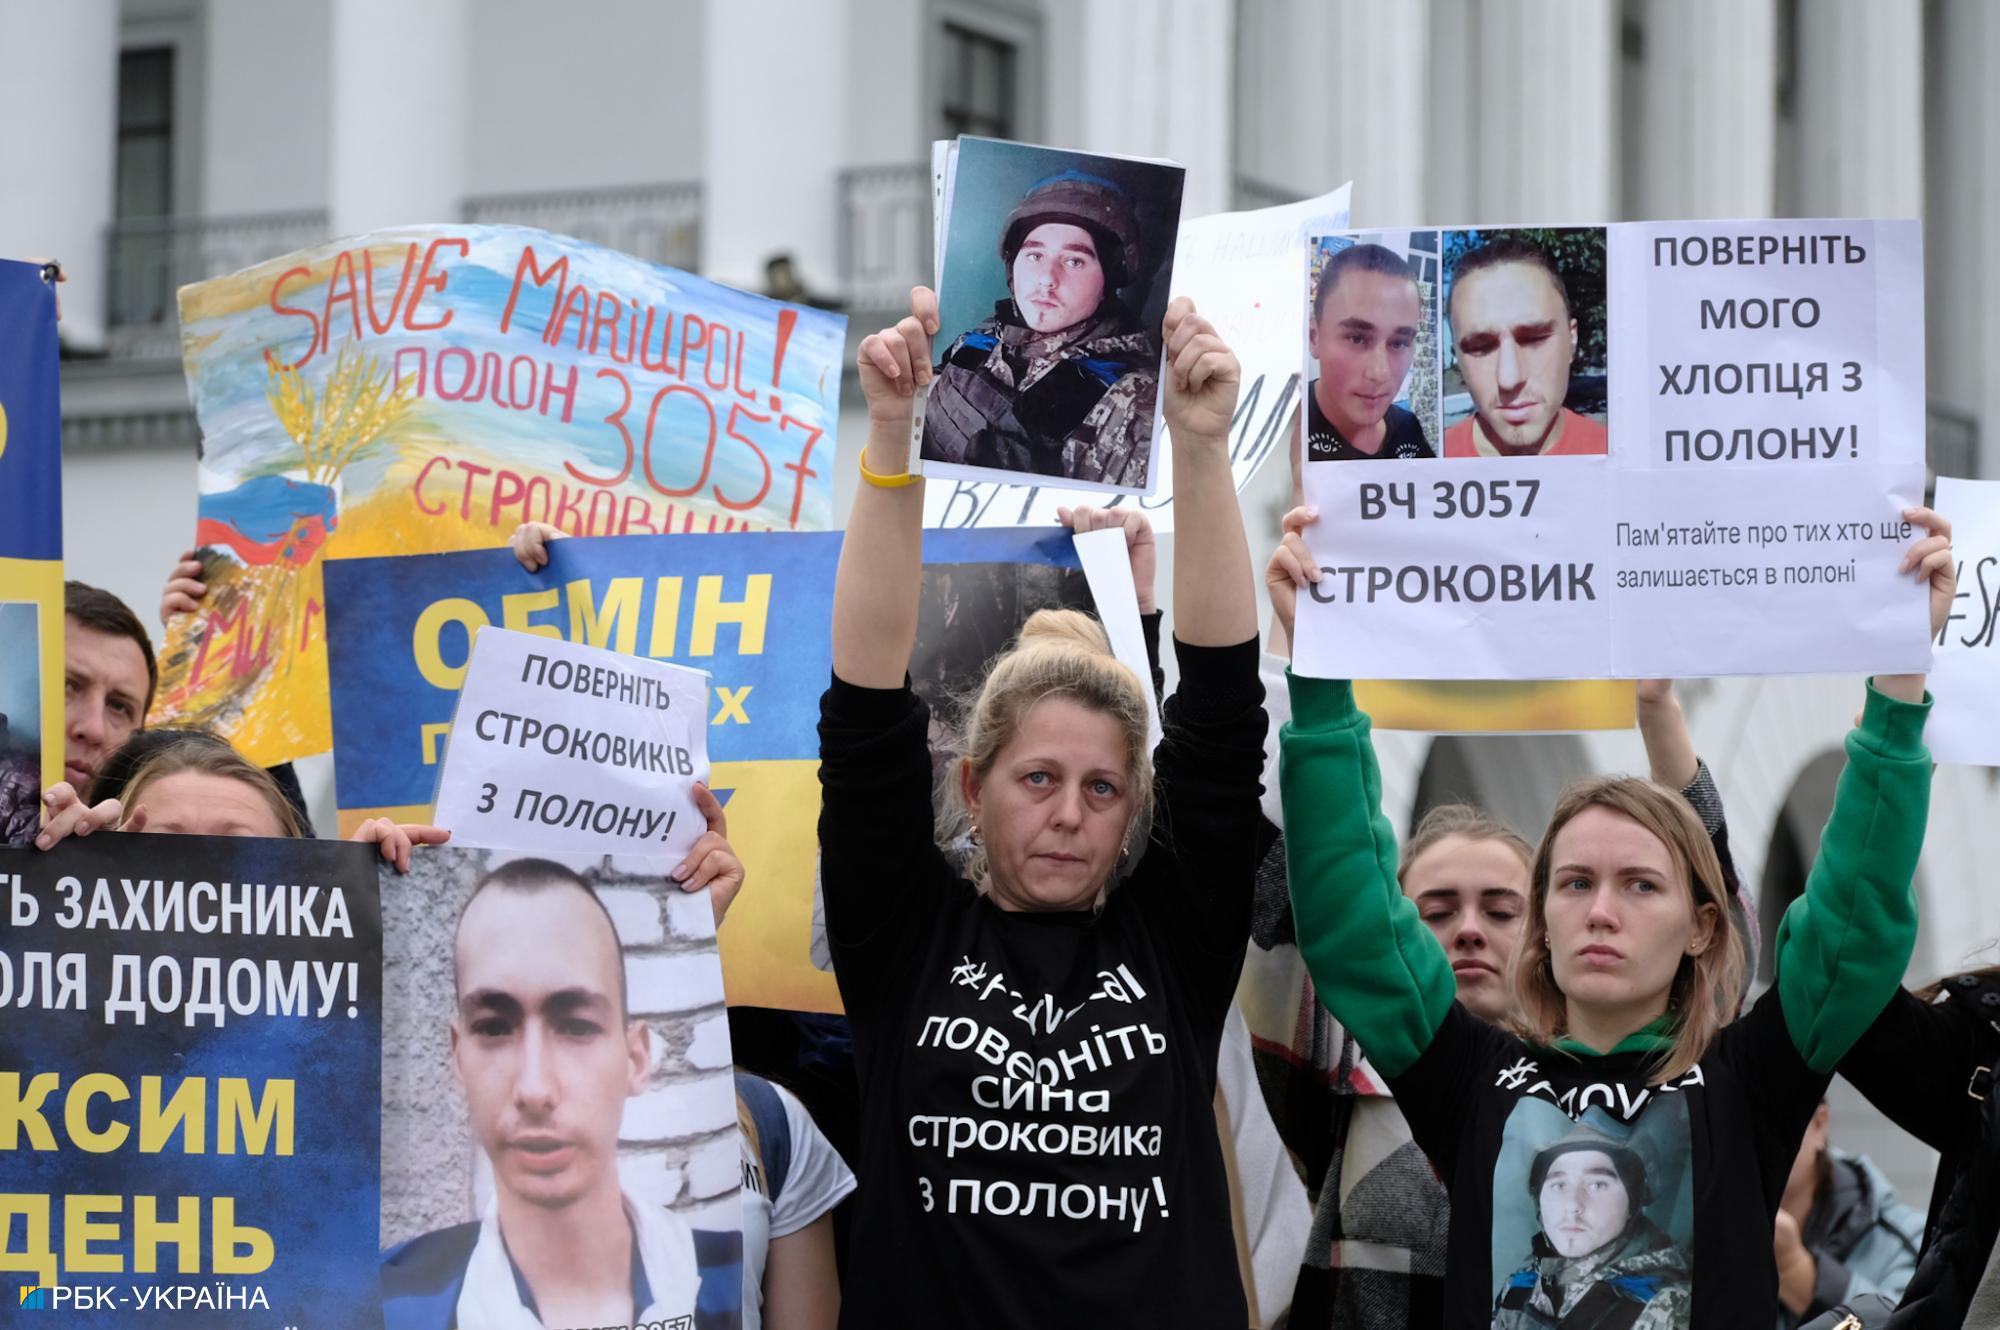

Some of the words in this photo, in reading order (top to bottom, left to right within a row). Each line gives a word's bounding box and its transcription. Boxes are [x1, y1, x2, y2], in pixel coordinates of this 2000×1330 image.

[1654, 235, 1866, 266] ПОВЕРНІТЬ
[264, 238, 469, 372] SAVE
[1700, 297, 1820, 330] МОГО
[1659, 362, 1828, 400] ХЛОПЦЯ
[1842, 361, 1862, 392] З
[394, 346, 578, 423] ПОЛОН
[563, 368, 823, 530] 3057
[1665, 424, 1858, 461] ПОЛОНУ!
[1360, 482, 1416, 520] ВЧ
[1433, 479, 1541, 519] 3057
[1616, 520, 1741, 547] Пам'ятайте
[1748, 524, 1787, 549] про
[1793, 523, 1831, 543] тих
[1836, 522, 1873, 542] хто
[1880, 520, 1912, 543] ще
[1309, 563, 1597, 604] СТРОКОВИК
[1616, 565, 1758, 588] залишається
[1765, 566, 1778, 585] в
[1784, 558, 1856, 584] полоні
[412, 574, 773, 690] ОБМІН
[521, 654, 671, 711] ПОВЕРНІТЬ
[475, 709, 694, 776] СТРОКОВИКІВ
[476, 782, 498, 814] З
[513, 789, 677, 842] ПОЛОНУ!
[55, 876, 354, 938] ЗАХИСНИКА
[104, 954, 359, 1028] ДОДОМУ!
[908, 1114, 1162, 1158] строковика
[0, 1193, 275, 1289] ДЕНЬ
